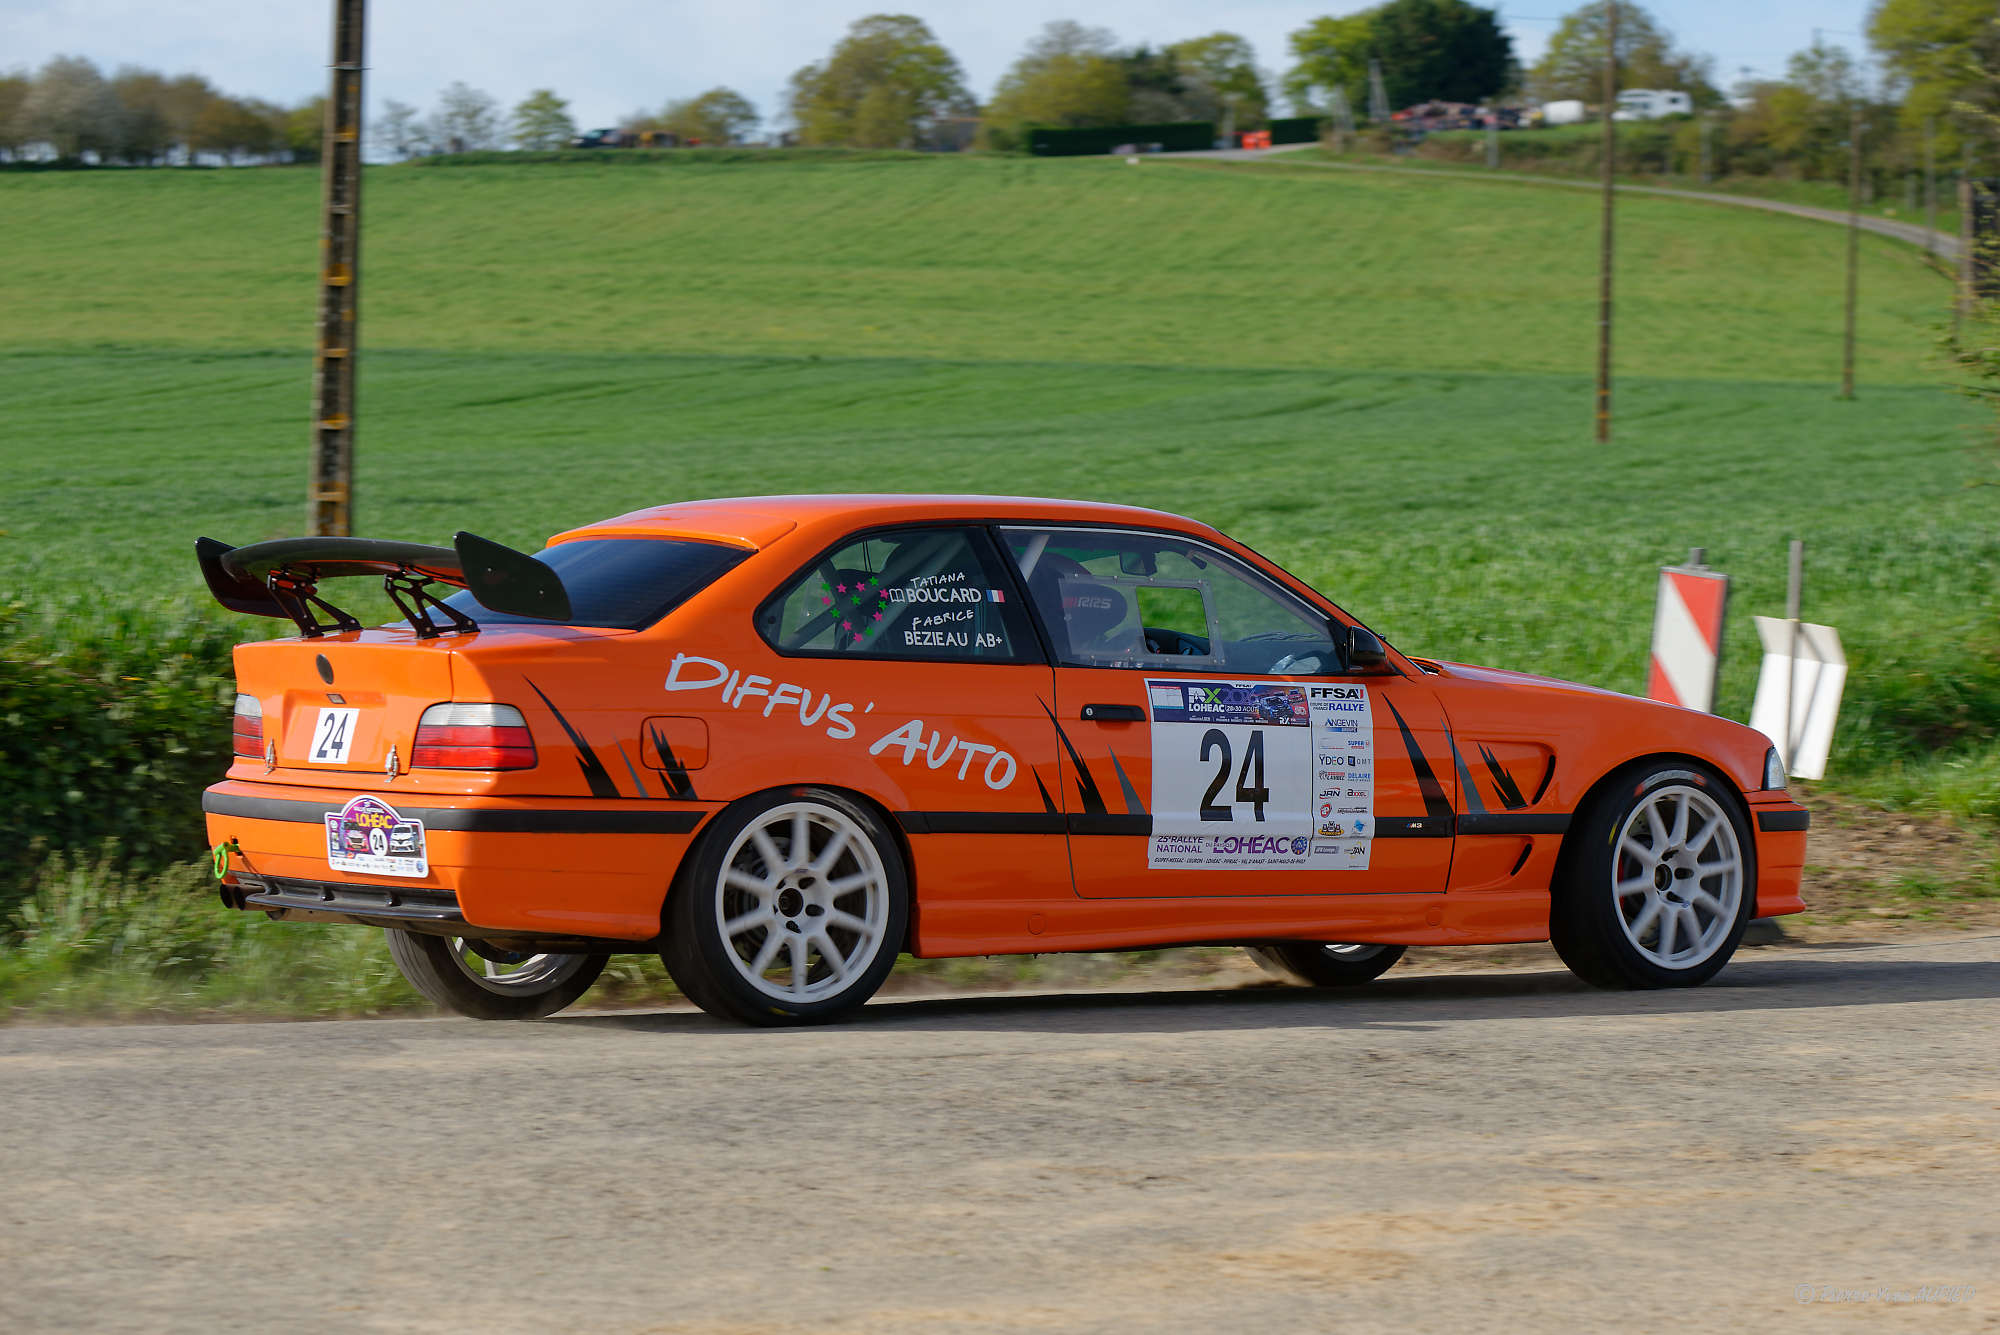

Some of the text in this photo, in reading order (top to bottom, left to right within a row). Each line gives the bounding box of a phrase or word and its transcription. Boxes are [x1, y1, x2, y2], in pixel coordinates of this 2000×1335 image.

[910, 572, 966, 588] TATIANA
[906, 588, 982, 603] BOUCARD
[912, 609, 974, 630] FABRICE
[904, 631, 1003, 648] BEZIEAU AB+
[1310, 687, 1359, 699] FFSA
[1188, 704, 1225, 713] LOHEAC
[1328, 702, 1364, 712] RALLYE
[665, 652, 1017, 790] DIFFUS' AUTO
[316, 712, 349, 759] 24
[1199, 728, 1270, 822] 24
[372, 834, 385, 851] 24
[1170, 836, 1203, 844] RALLYE
[1212, 834, 1290, 854] LOHÉAC
[1156, 844, 1203, 854] NATIONAL
